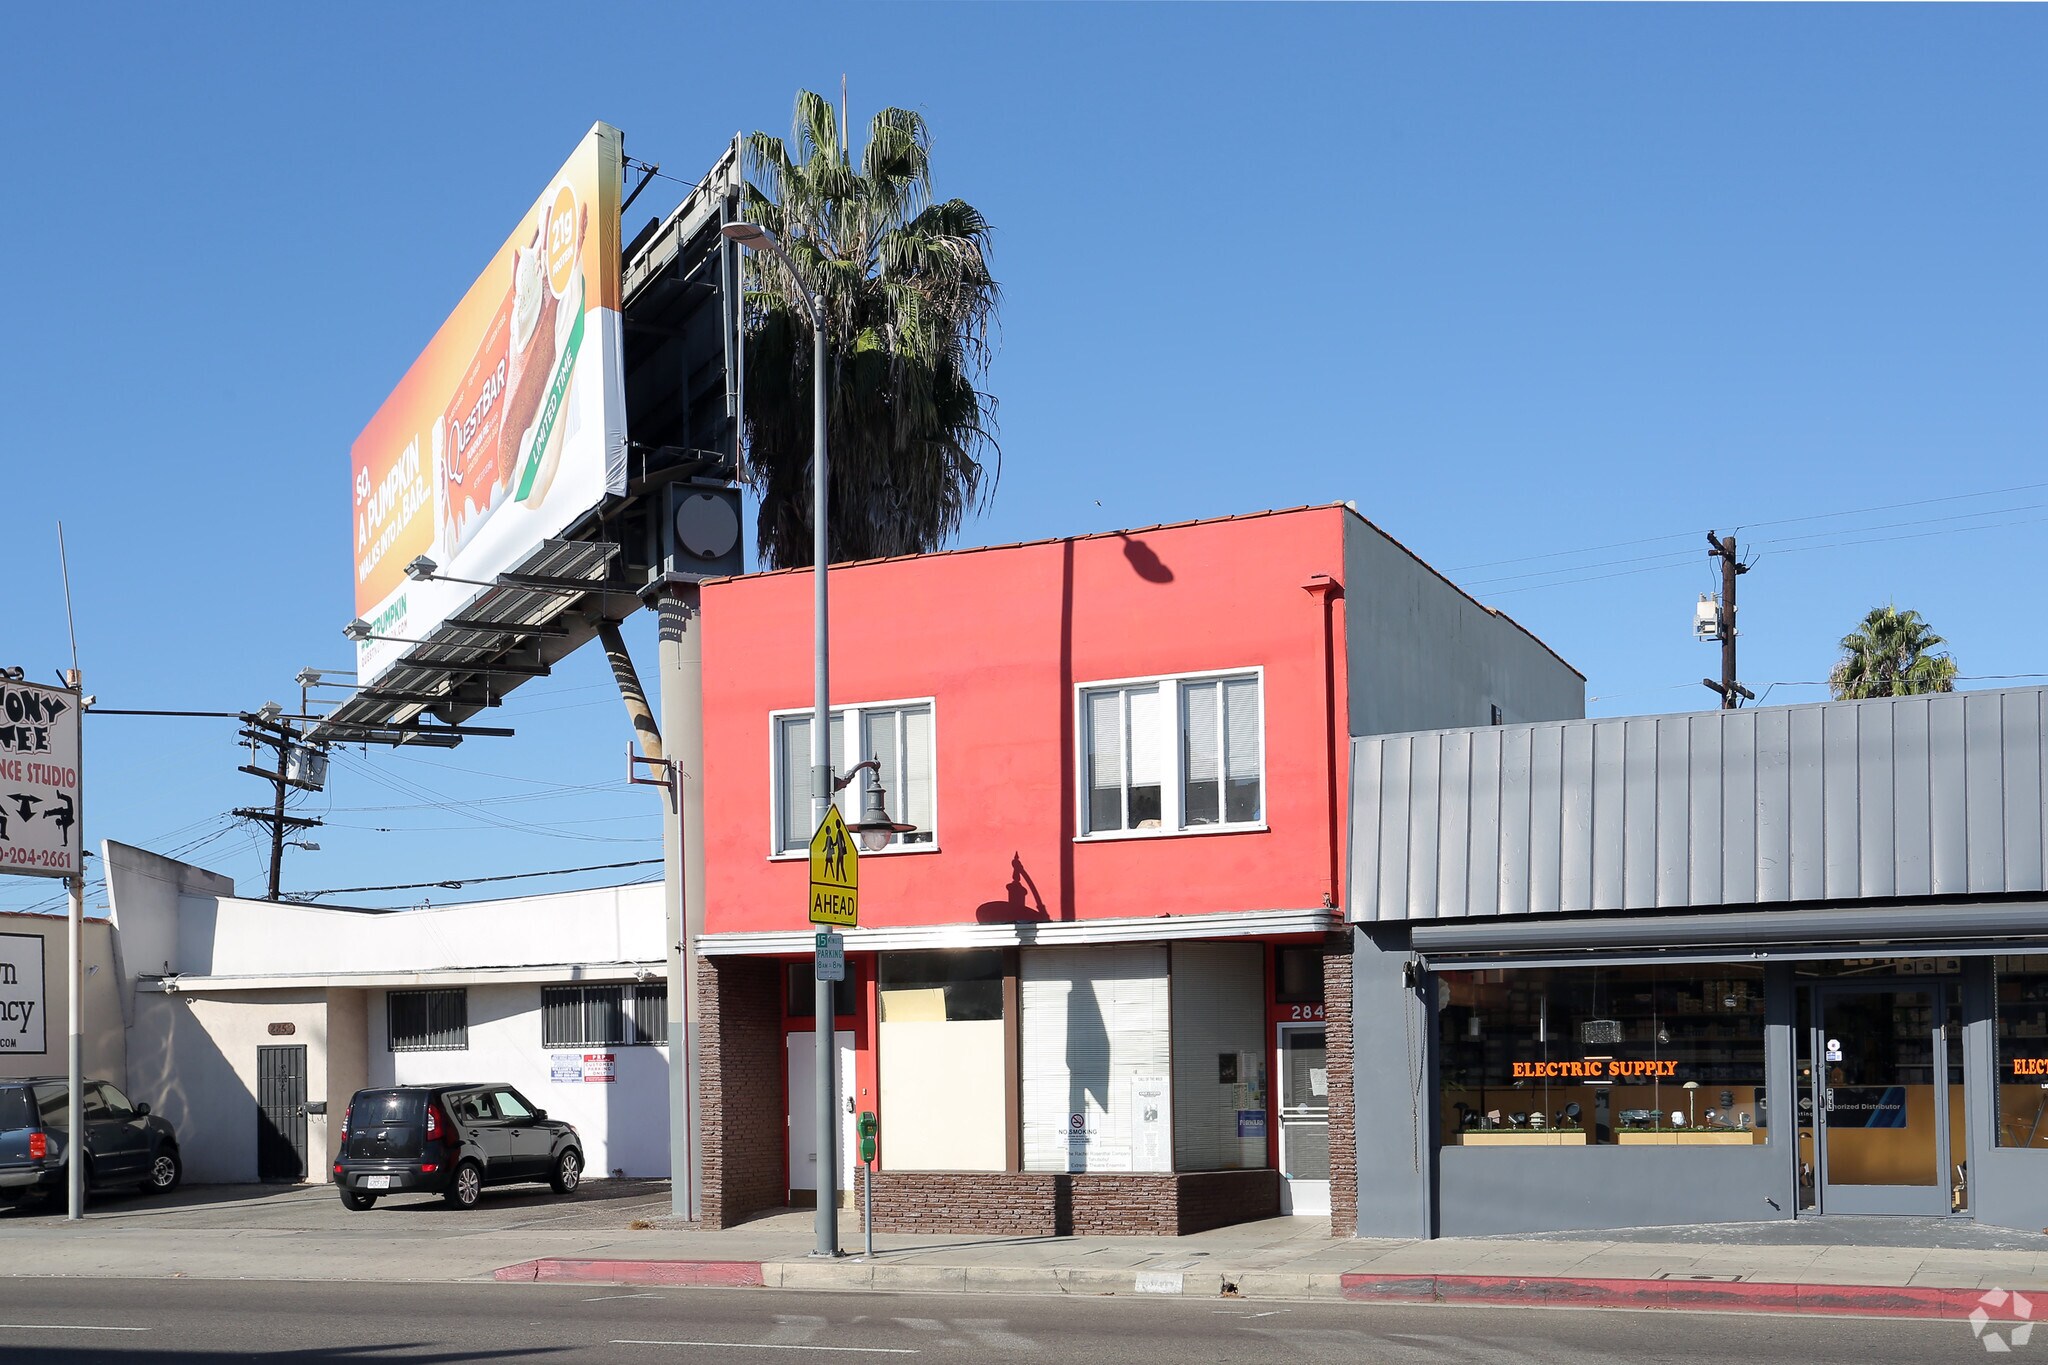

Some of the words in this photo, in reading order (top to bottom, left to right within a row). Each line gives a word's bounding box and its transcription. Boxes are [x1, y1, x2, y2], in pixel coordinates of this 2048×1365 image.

[552, 207, 573, 254] 21g
[533, 393, 557, 465] LIMITED
[556, 346, 573, 394] TIME
[358, 512, 367, 553] A
[367, 432, 420, 538] PUMPKIN
[358, 540, 380, 584] WALKS
[380, 520, 396, 558] INTO
[396, 512, 403, 537] A
[27, 762, 76, 788] STUDIO
[813, 893, 855, 916] AHEAD
[817, 935, 827, 946] 15
[828, 937, 842, 945] MINUTE
[817, 949, 842, 958] PARKING
[1291, 1005, 1324, 1019] 284
[1512, 1062, 1602, 1077] ELECTRIC
[1608, 1061, 1678, 1076] SUPPLY
